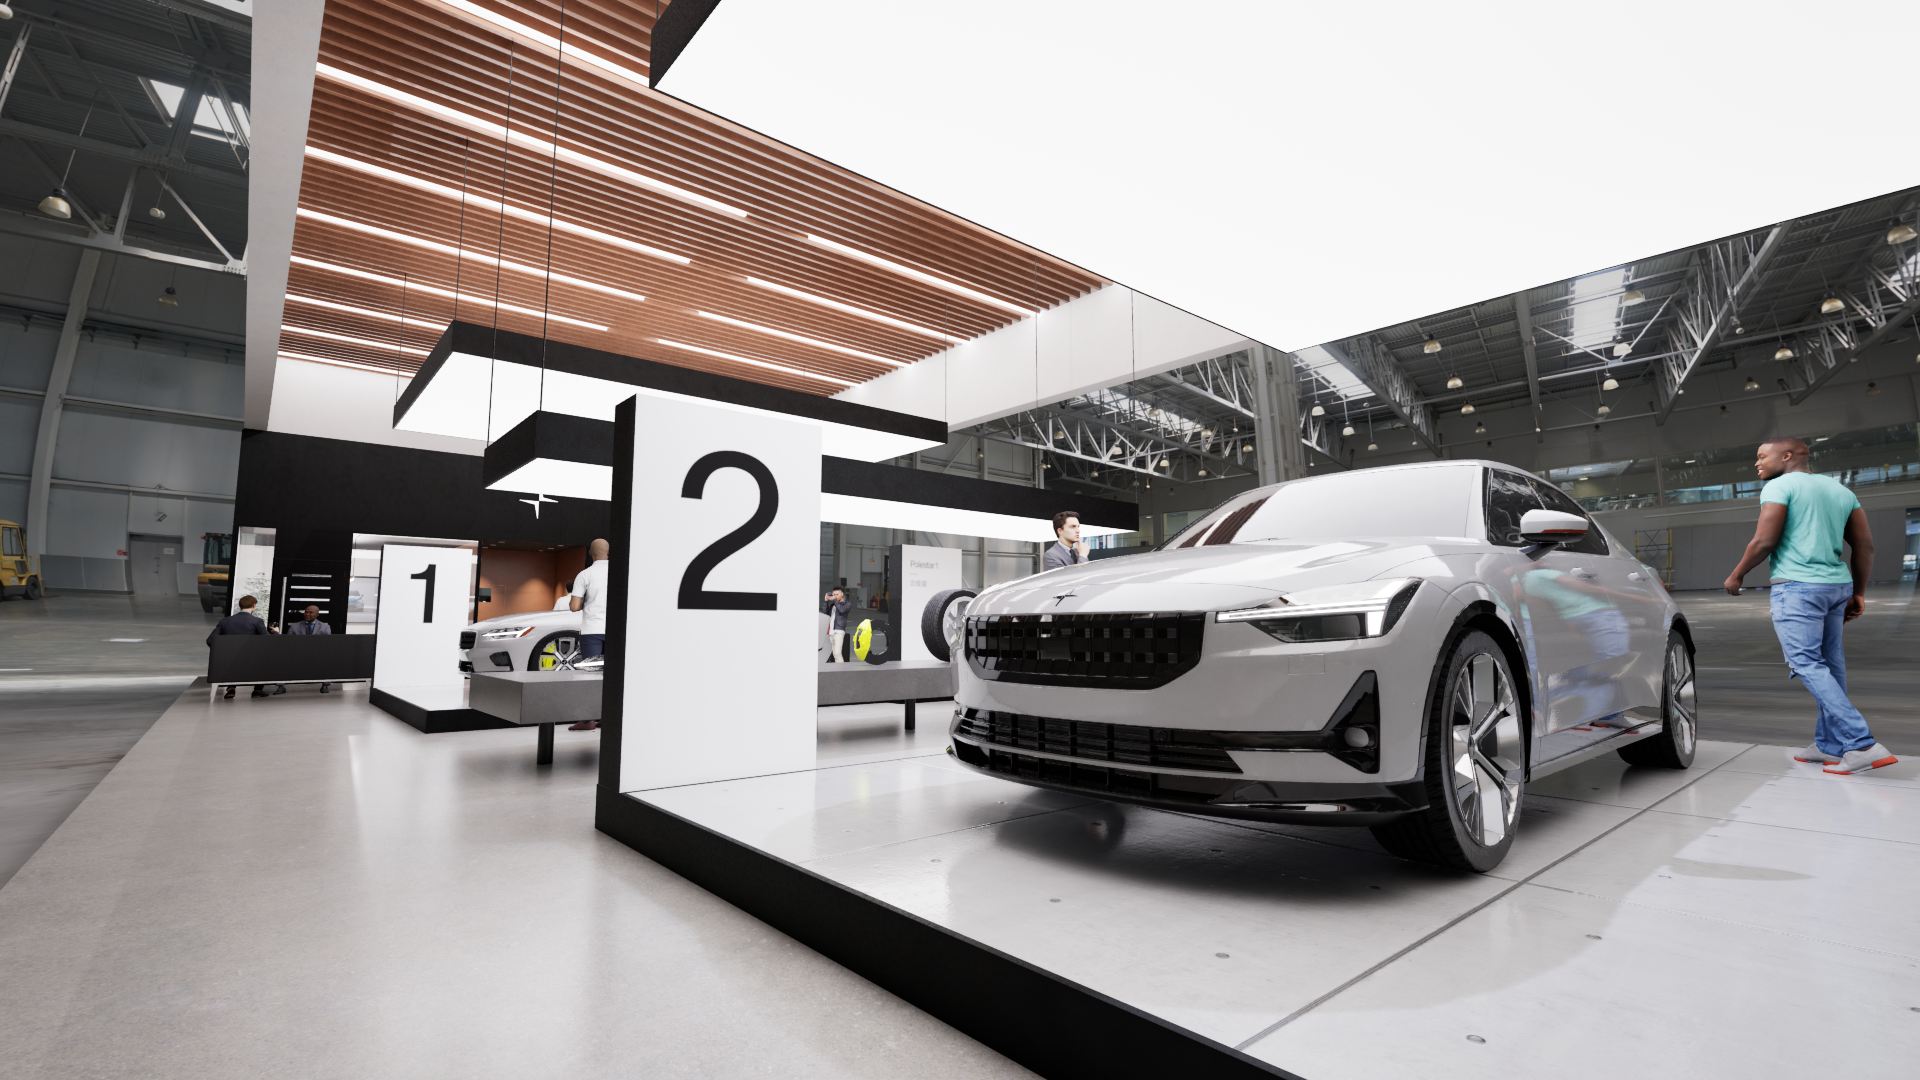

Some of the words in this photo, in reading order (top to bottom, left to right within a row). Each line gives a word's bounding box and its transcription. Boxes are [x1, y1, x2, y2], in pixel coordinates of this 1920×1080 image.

[678, 451, 778, 611] 2
[410, 564, 436, 623] 1
[910, 560, 935, 569] Polestar
